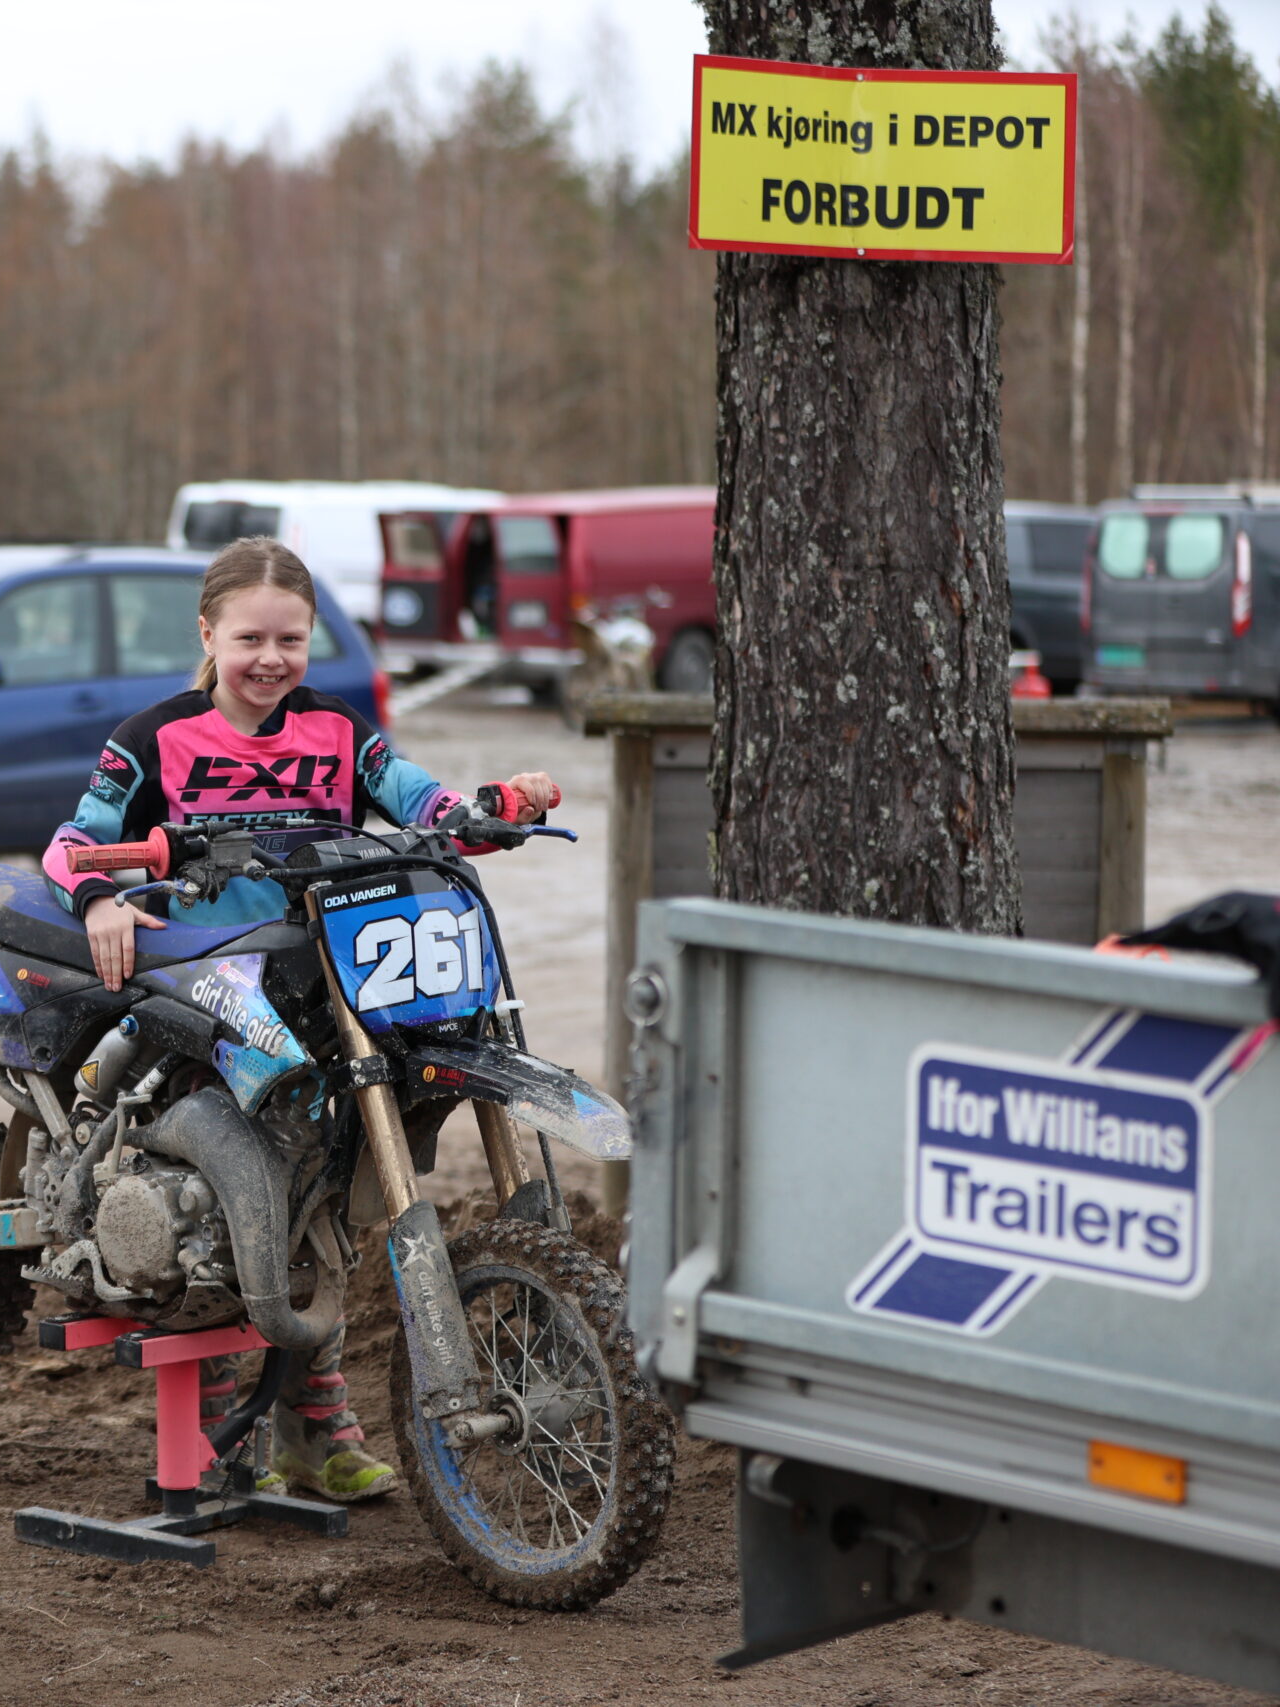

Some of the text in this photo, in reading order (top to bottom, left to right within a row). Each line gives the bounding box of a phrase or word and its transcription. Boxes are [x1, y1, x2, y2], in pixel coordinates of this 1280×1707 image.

[711, 101, 1051, 154] MX kjøring i DEPOT
[761, 178, 985, 231] FORBUDT
[176, 754, 343, 802] FXR
[357, 846, 393, 860] YAMAHA
[323, 883, 397, 910] ODA VANGEN
[354, 906, 484, 1013] 261
[191, 974, 222, 1013] dirt
[219, 988, 248, 1032] bike
[927, 1074, 1189, 1173] Ifor Williams
[930, 1160, 1181, 1260] Trailers
